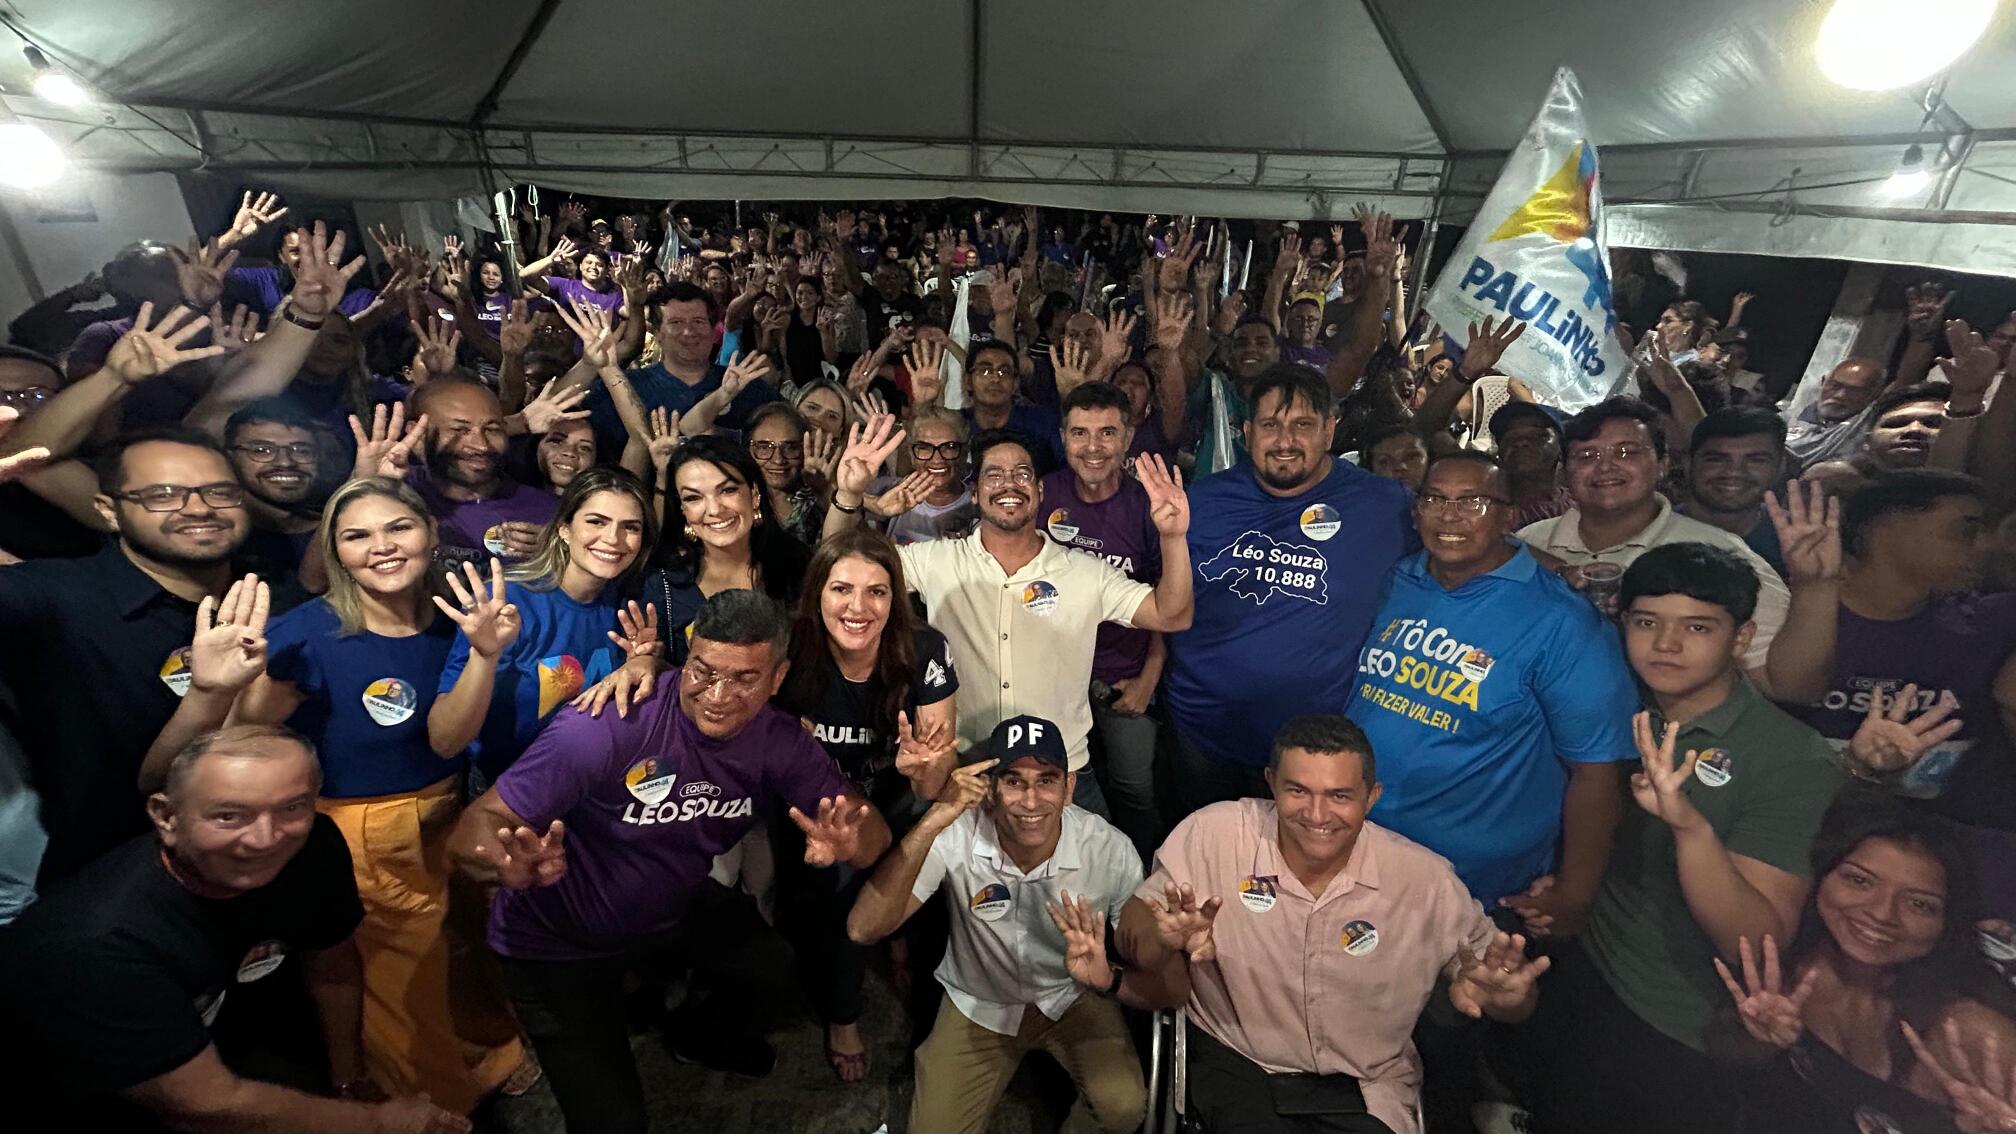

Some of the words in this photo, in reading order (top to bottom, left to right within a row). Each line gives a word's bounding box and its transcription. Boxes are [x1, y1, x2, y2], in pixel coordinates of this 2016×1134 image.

[1074, 536, 1099, 548] EQUIPE
[1232, 544, 1265, 561] Léo
[1268, 548, 1324, 571] Souza
[1254, 566, 1317, 590] 10.888
[1394, 655, 1480, 712] SOUZA
[1407, 701, 1452, 731] VALER
[685, 783, 715, 794] EQUIPE
